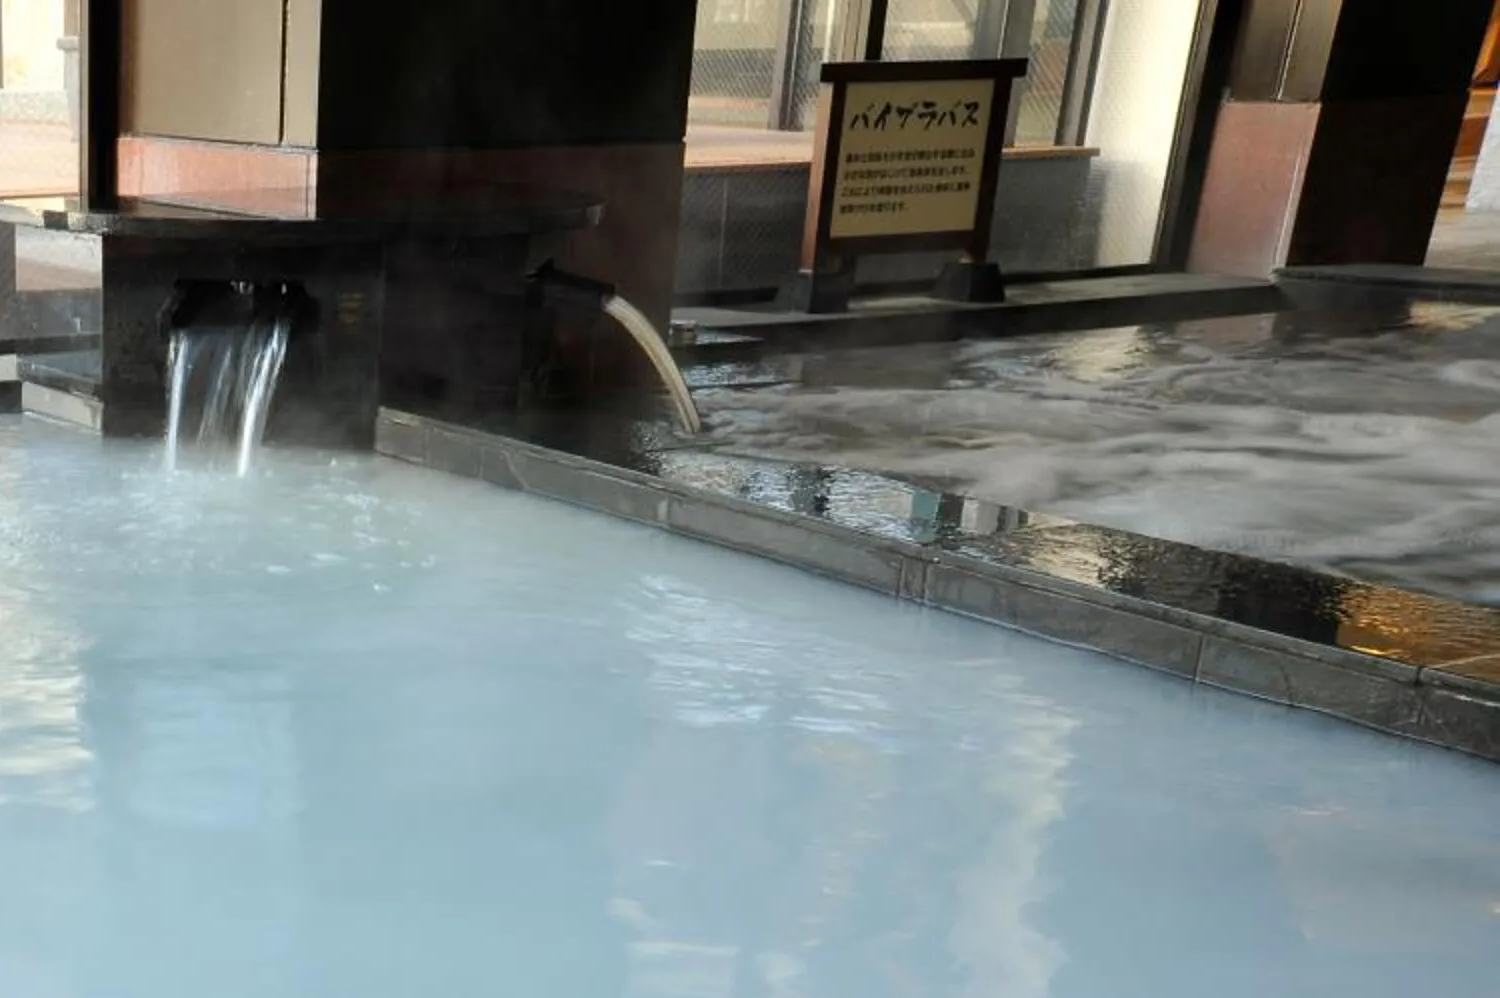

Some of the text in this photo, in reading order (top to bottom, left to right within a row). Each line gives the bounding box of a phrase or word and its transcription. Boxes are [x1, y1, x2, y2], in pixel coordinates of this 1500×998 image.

[851, 100, 981, 131] バイブラバス
